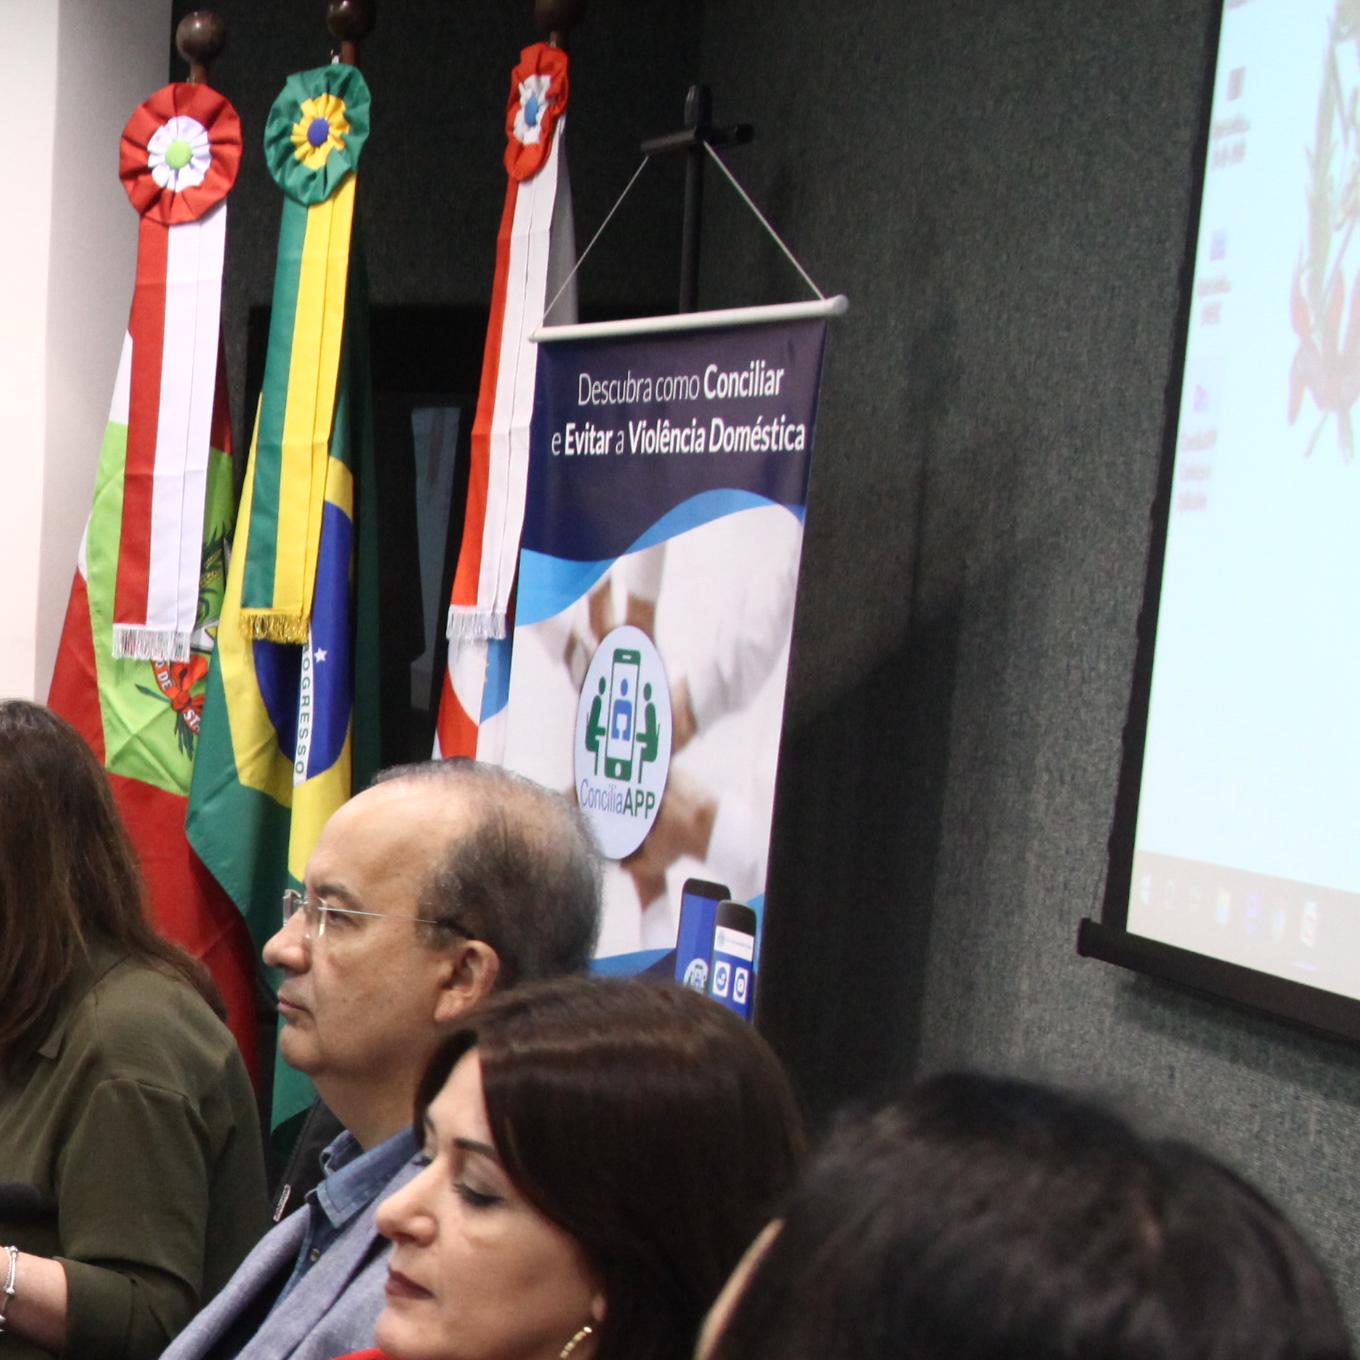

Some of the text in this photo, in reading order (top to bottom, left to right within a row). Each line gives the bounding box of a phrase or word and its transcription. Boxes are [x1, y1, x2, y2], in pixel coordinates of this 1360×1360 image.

[578, 359, 784, 406] Descubra como Conciliar
[551, 413, 806, 456] e Evitar a Violência Doméstica
[580, 778, 656, 820] ConciliaAPP
